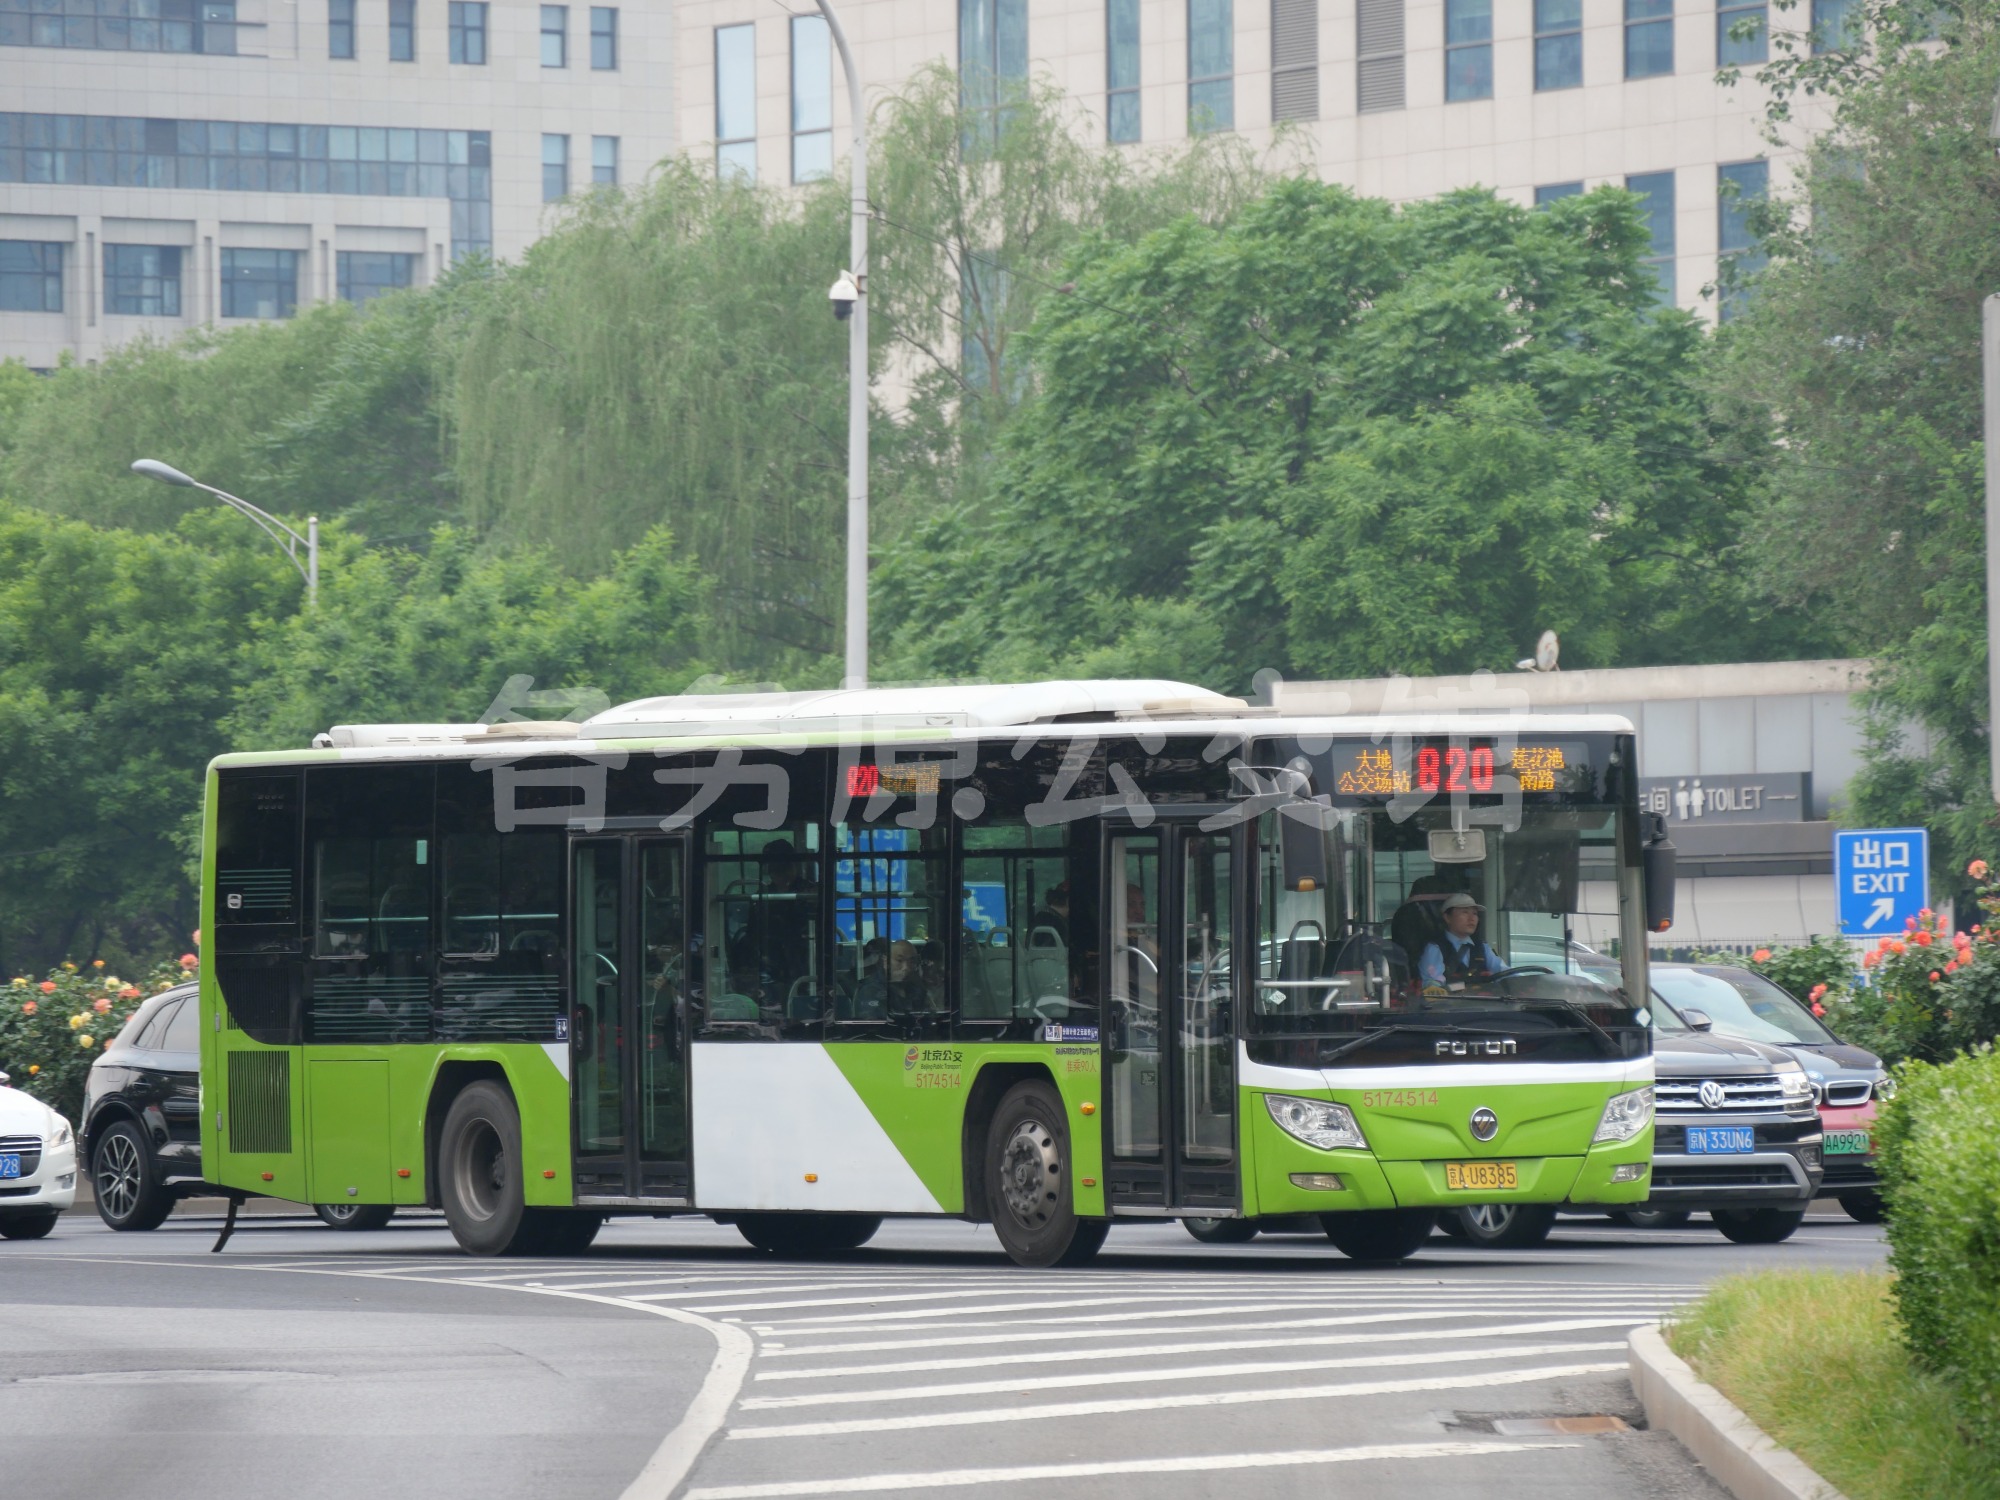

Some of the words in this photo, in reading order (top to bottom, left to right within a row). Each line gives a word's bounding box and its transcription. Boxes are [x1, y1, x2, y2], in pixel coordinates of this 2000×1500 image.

[1355, 750, 1393, 772] 大地
[1511, 748, 1564, 769] 莲花池
[846, 765, 878, 796] 820
[1418, 748, 1494, 792] 820
[1520, 770, 1555, 790] 南路
[1338, 770, 1411, 793] 公交场站
[1705, 785, 1765, 812] TOILET
[1852, 838, 1910, 869] 出口
[1852, 872, 1910, 894] EXIT
[921, 1049, 963, 1062] 北京公交
[1435, 1040, 1517, 1056] FOTON
[916, 1073, 961, 1089] 5174514
[1363, 1090, 1438, 1107] 5174514
[0, 1157, 19, 1174] 28
